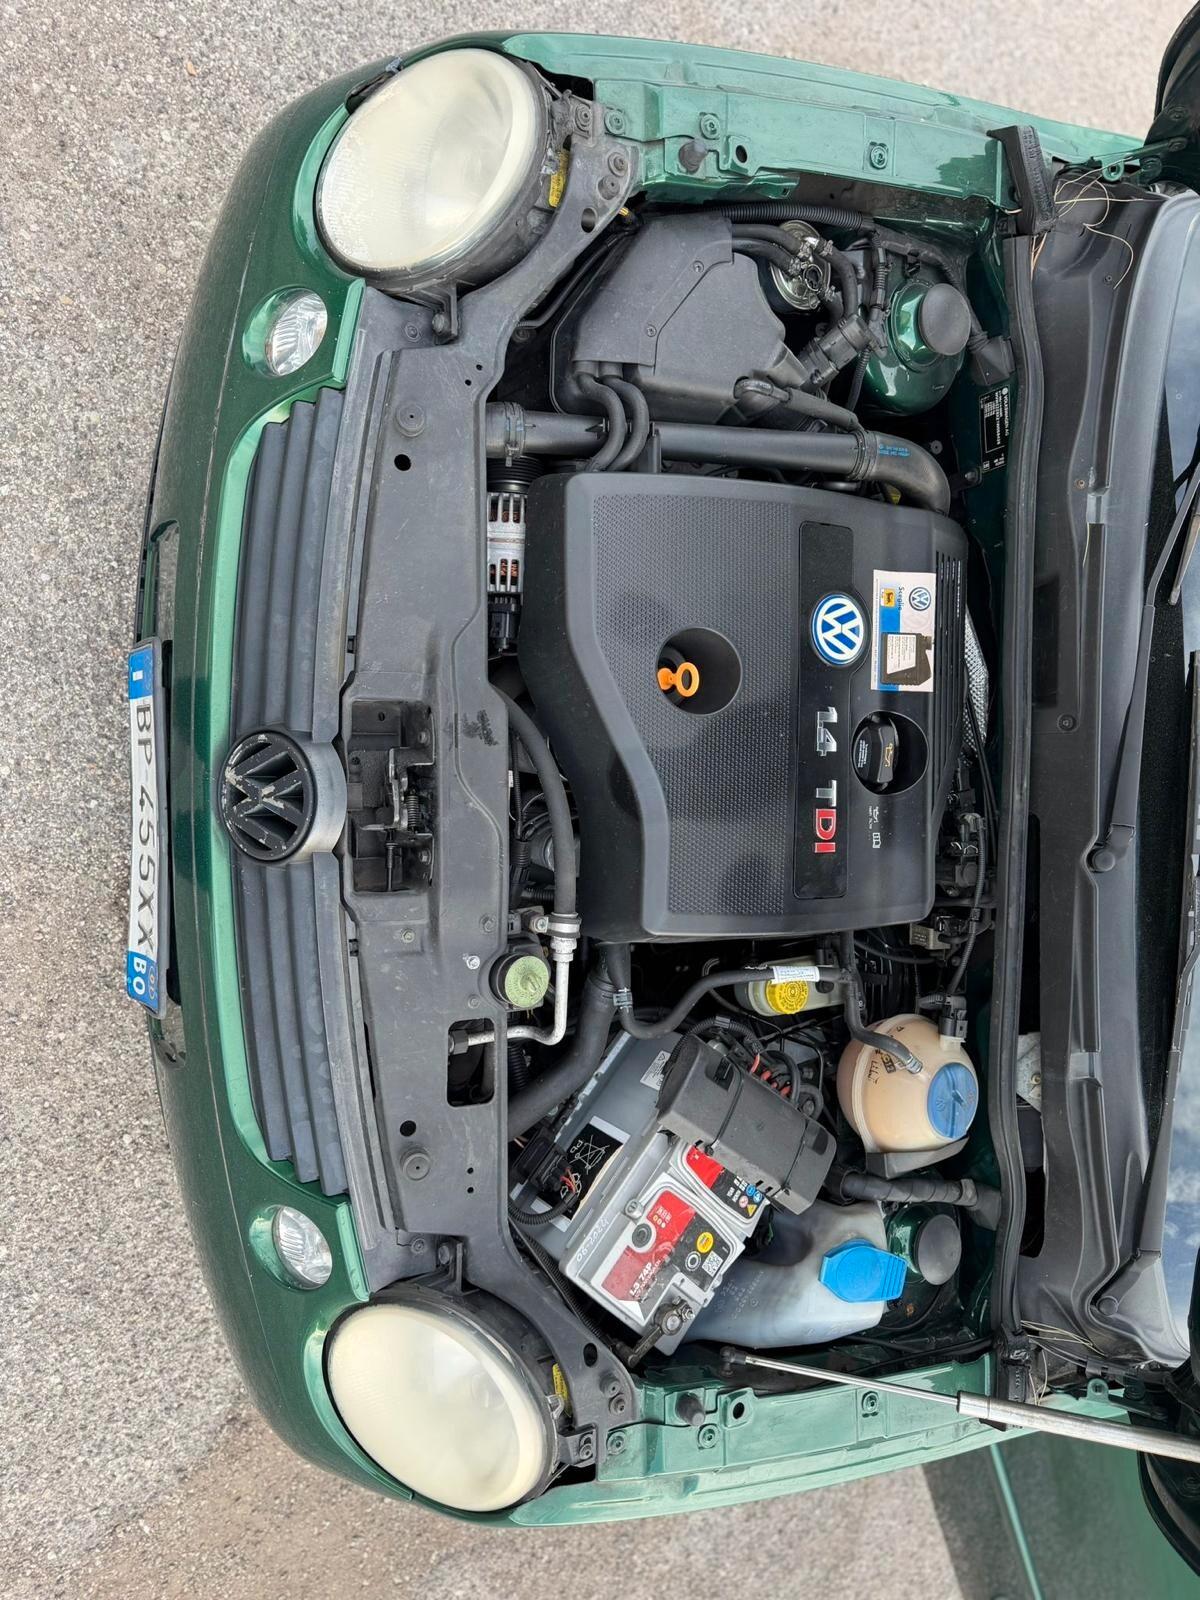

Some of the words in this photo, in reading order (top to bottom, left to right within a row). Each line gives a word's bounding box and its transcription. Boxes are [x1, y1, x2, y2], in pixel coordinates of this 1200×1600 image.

[136, 704, 152, 766] BP
[814, 780, 837, 853] TDI
[136, 784, 156, 954] 455XX
[133, 957, 147, 995] BO
[570, 1140, 583, 1153] Pb
